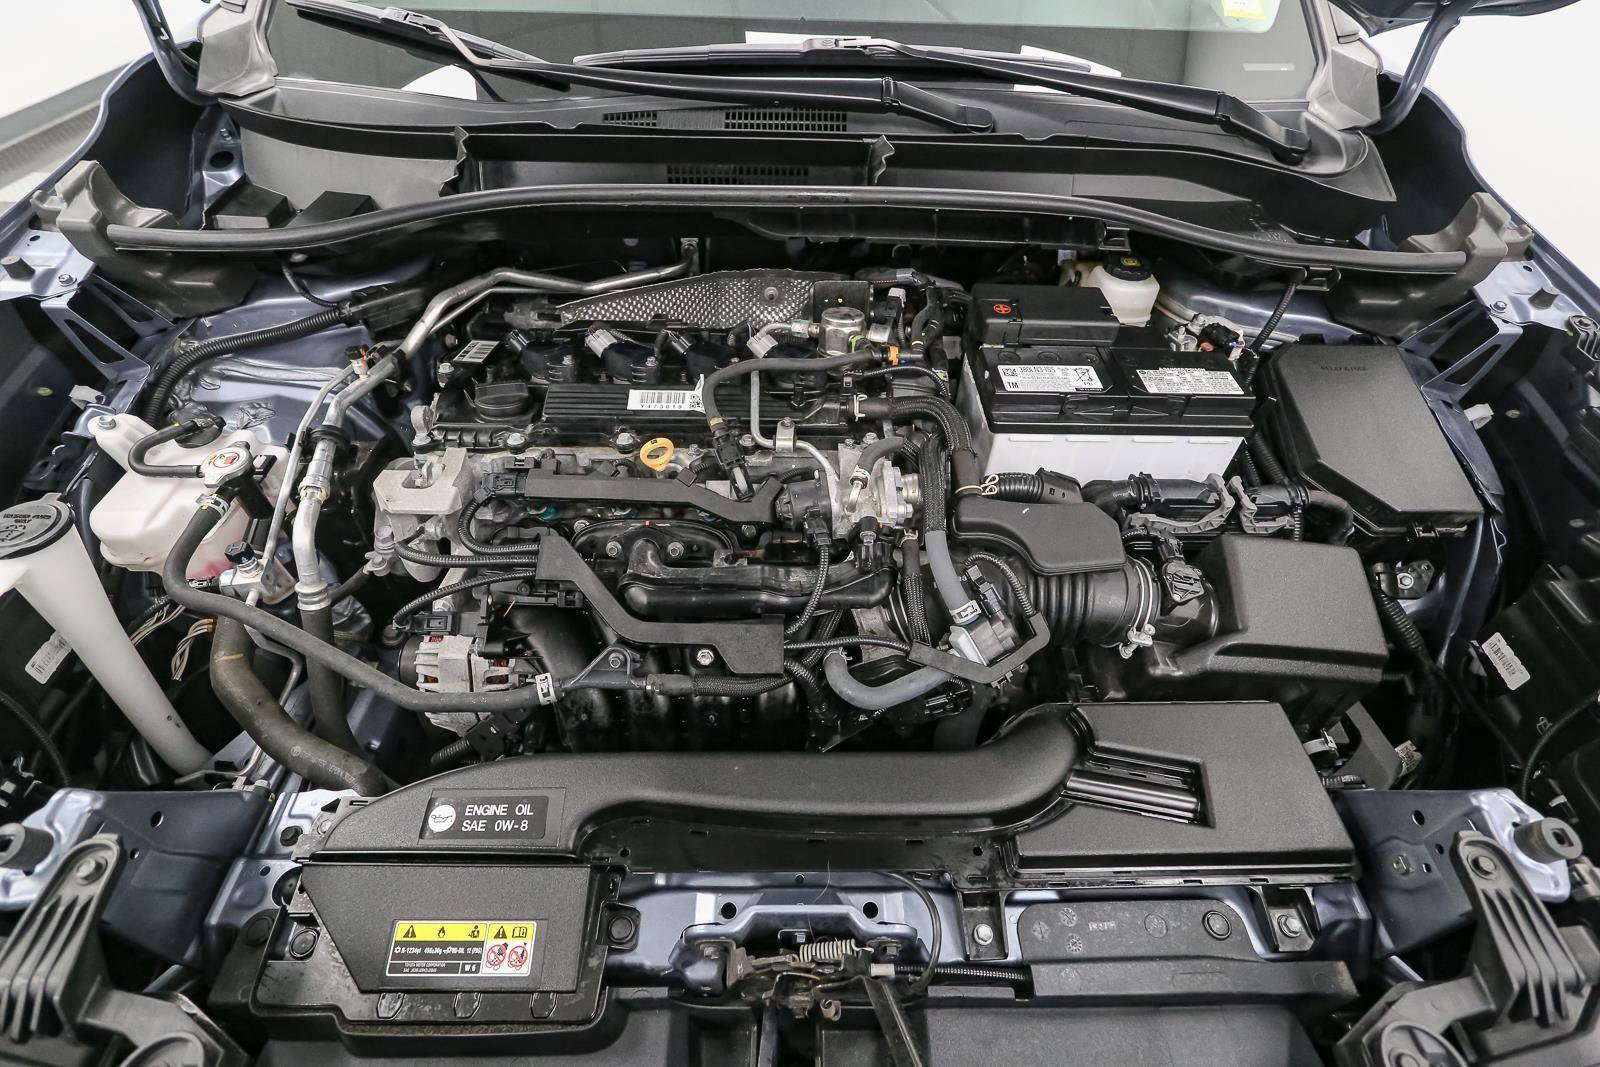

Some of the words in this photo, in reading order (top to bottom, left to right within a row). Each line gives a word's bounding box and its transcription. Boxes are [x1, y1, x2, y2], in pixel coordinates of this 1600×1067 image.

[465, 804, 509, 816] ENGINE
[515, 804, 534, 816] OIL
[461, 820, 487, 832] SAE
[494, 820, 529, 832] 0W-8
